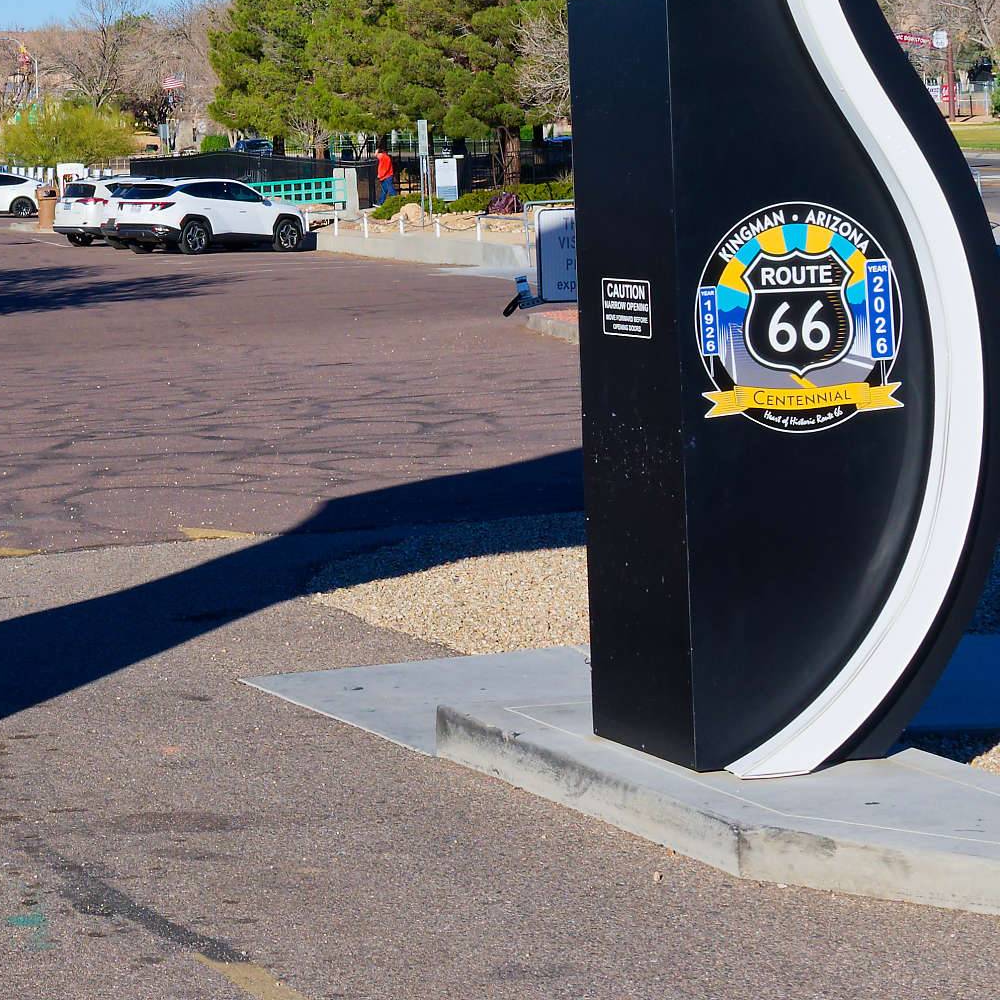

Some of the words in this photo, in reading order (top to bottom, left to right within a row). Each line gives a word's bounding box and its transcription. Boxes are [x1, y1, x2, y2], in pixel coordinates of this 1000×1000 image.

[718, 209, 785, 263] KINGMAN
[805, 209, 872, 254] ARIZONA
[761, 264, 833, 286] ROUTE
[867, 264, 888, 273] YEAR
[606, 283, 646, 300] CAUTION
[604, 300, 626, 310] NARROW
[626, 302, 649, 312] OPENING
[873, 276, 888, 354] 2026
[703, 300, 716, 352] 1926
[768, 300, 831, 353] 66
[753, 388, 852, 406] CENTENNIAL
[763, 410, 781, 424] Heart
[781, 416, 789, 428] of
[789, 416, 816, 426] Historic
[816, 412, 834, 424] Route
[833, 406, 844, 417] 66
